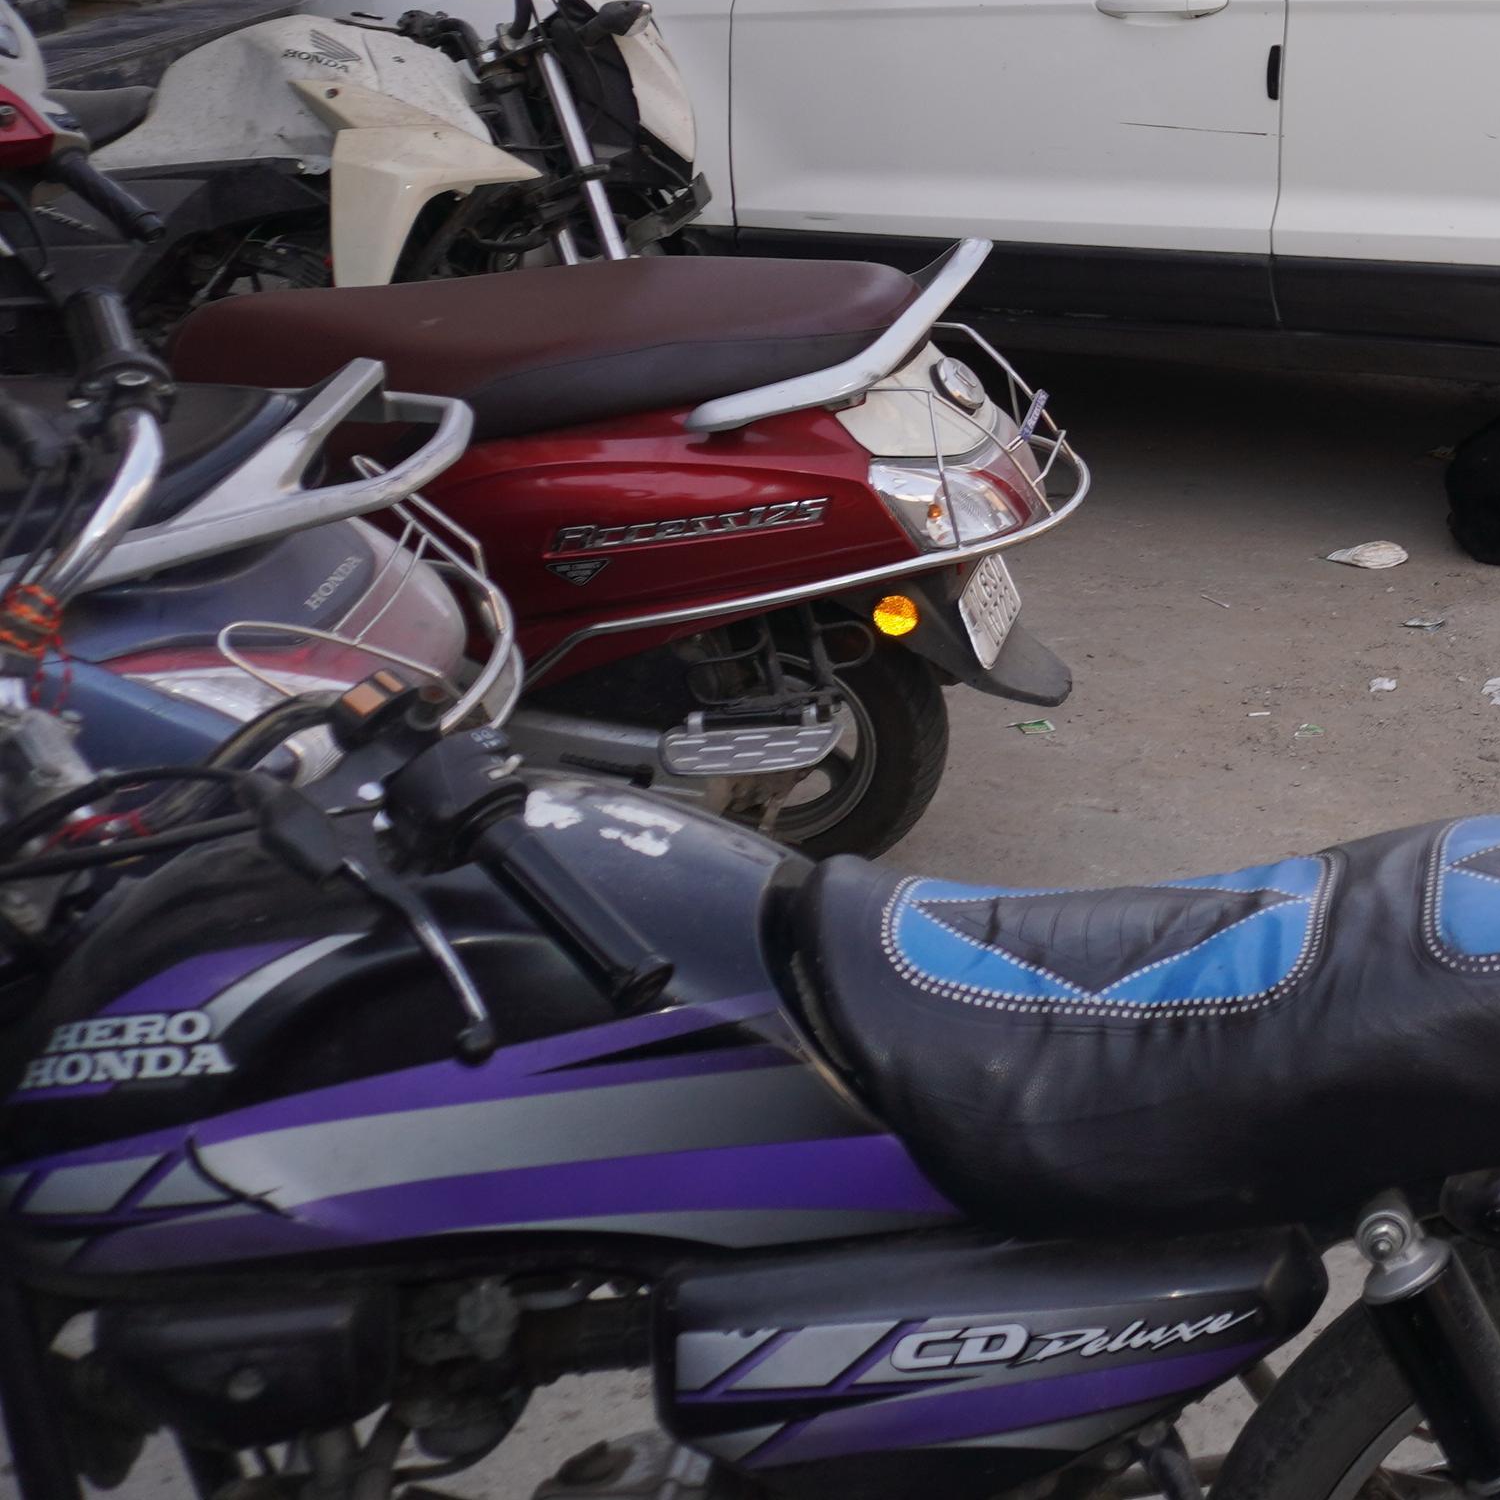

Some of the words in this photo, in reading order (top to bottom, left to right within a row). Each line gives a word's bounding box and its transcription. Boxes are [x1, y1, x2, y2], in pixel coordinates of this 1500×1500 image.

[280, 48, 350, 73] HONDA
[302, 555, 363, 612] HONDA
[44, 1009, 213, 1055] HERO
[17, 1042, 238, 1091] HONDA
[889, 1322, 1031, 1372] CD
[1009, 1306, 1258, 1370] Deluxe
